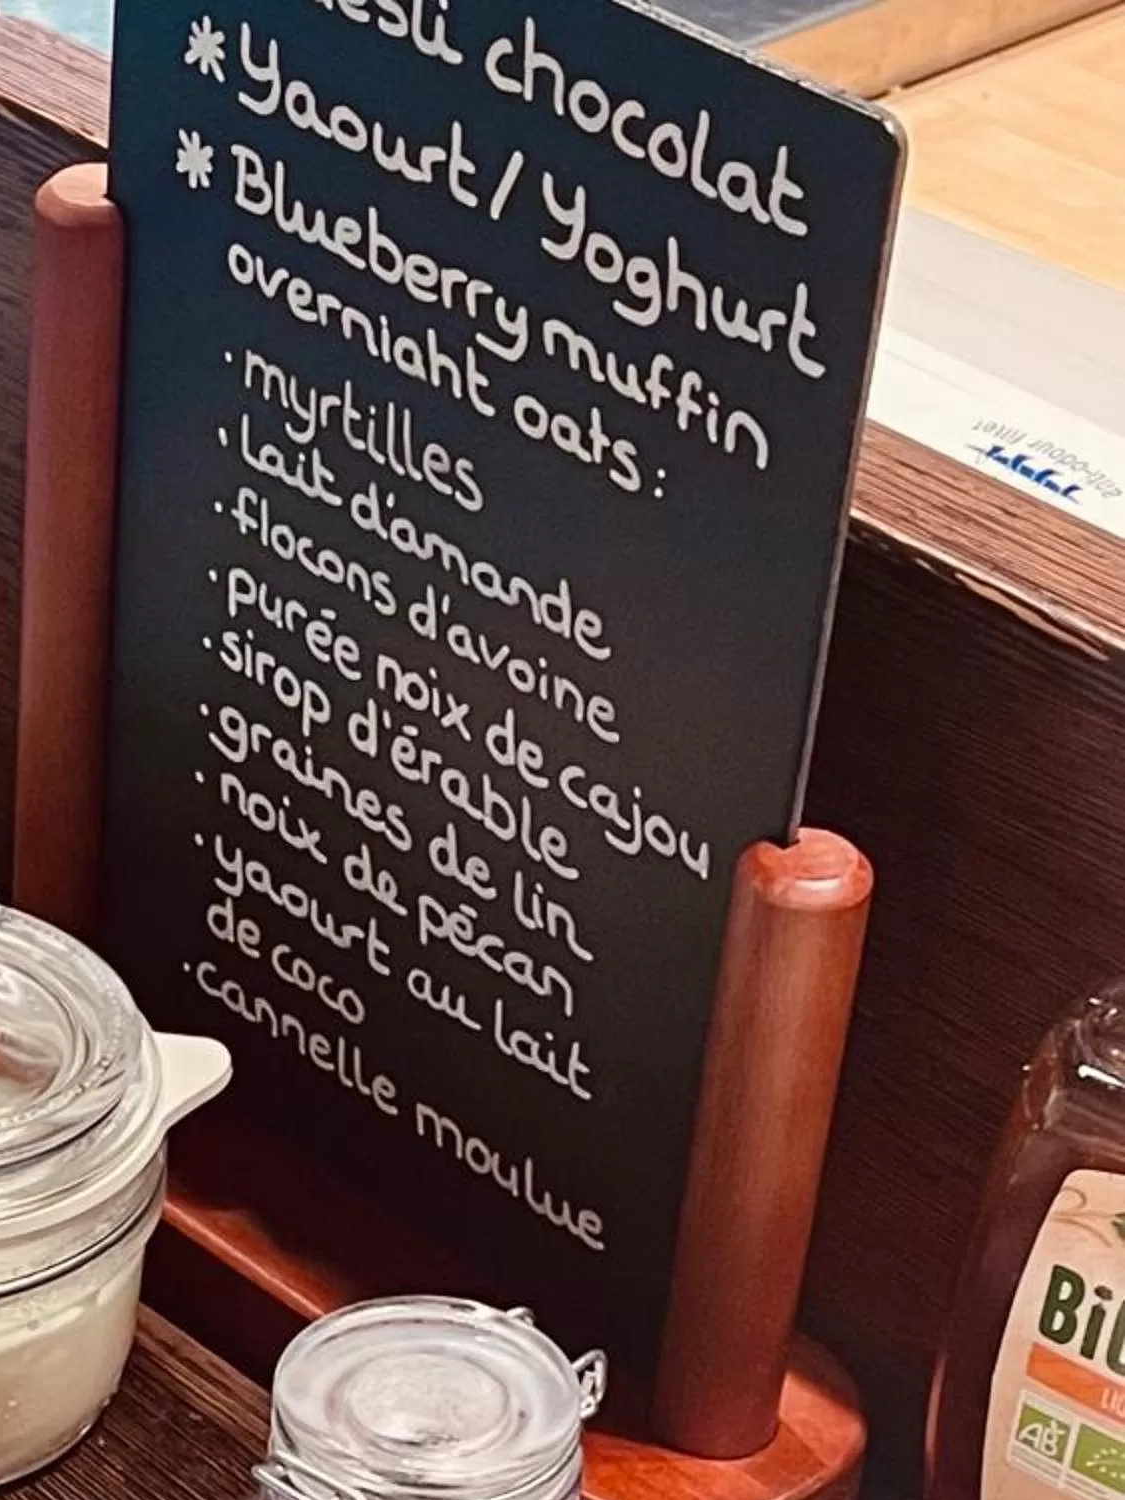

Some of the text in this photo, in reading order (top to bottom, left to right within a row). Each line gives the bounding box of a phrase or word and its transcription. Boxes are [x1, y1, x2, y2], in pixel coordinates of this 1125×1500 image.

[238, 21, 478, 208] Yaourt
[316, 0, 808, 237] esli chocolat
[230, 143, 768, 470] Blueberry muffin
[244, 349, 483, 512] myrtilles
[230, 487, 620, 743] flocons d'avoine
[241, 413, 611, 661] lait d'amande
[208, 706, 594, 961] graines de lin
[219, 628, 580, 880] sirop d'érable
[228, 567, 709, 880] purée noix de cajou
[207, 897, 365, 1023] de coco
[214, 835, 592, 1100] yaourt au lait
[220, 773, 573, 1017] noix de pécan
[197, 962, 604, 1250] cannelle moulue
